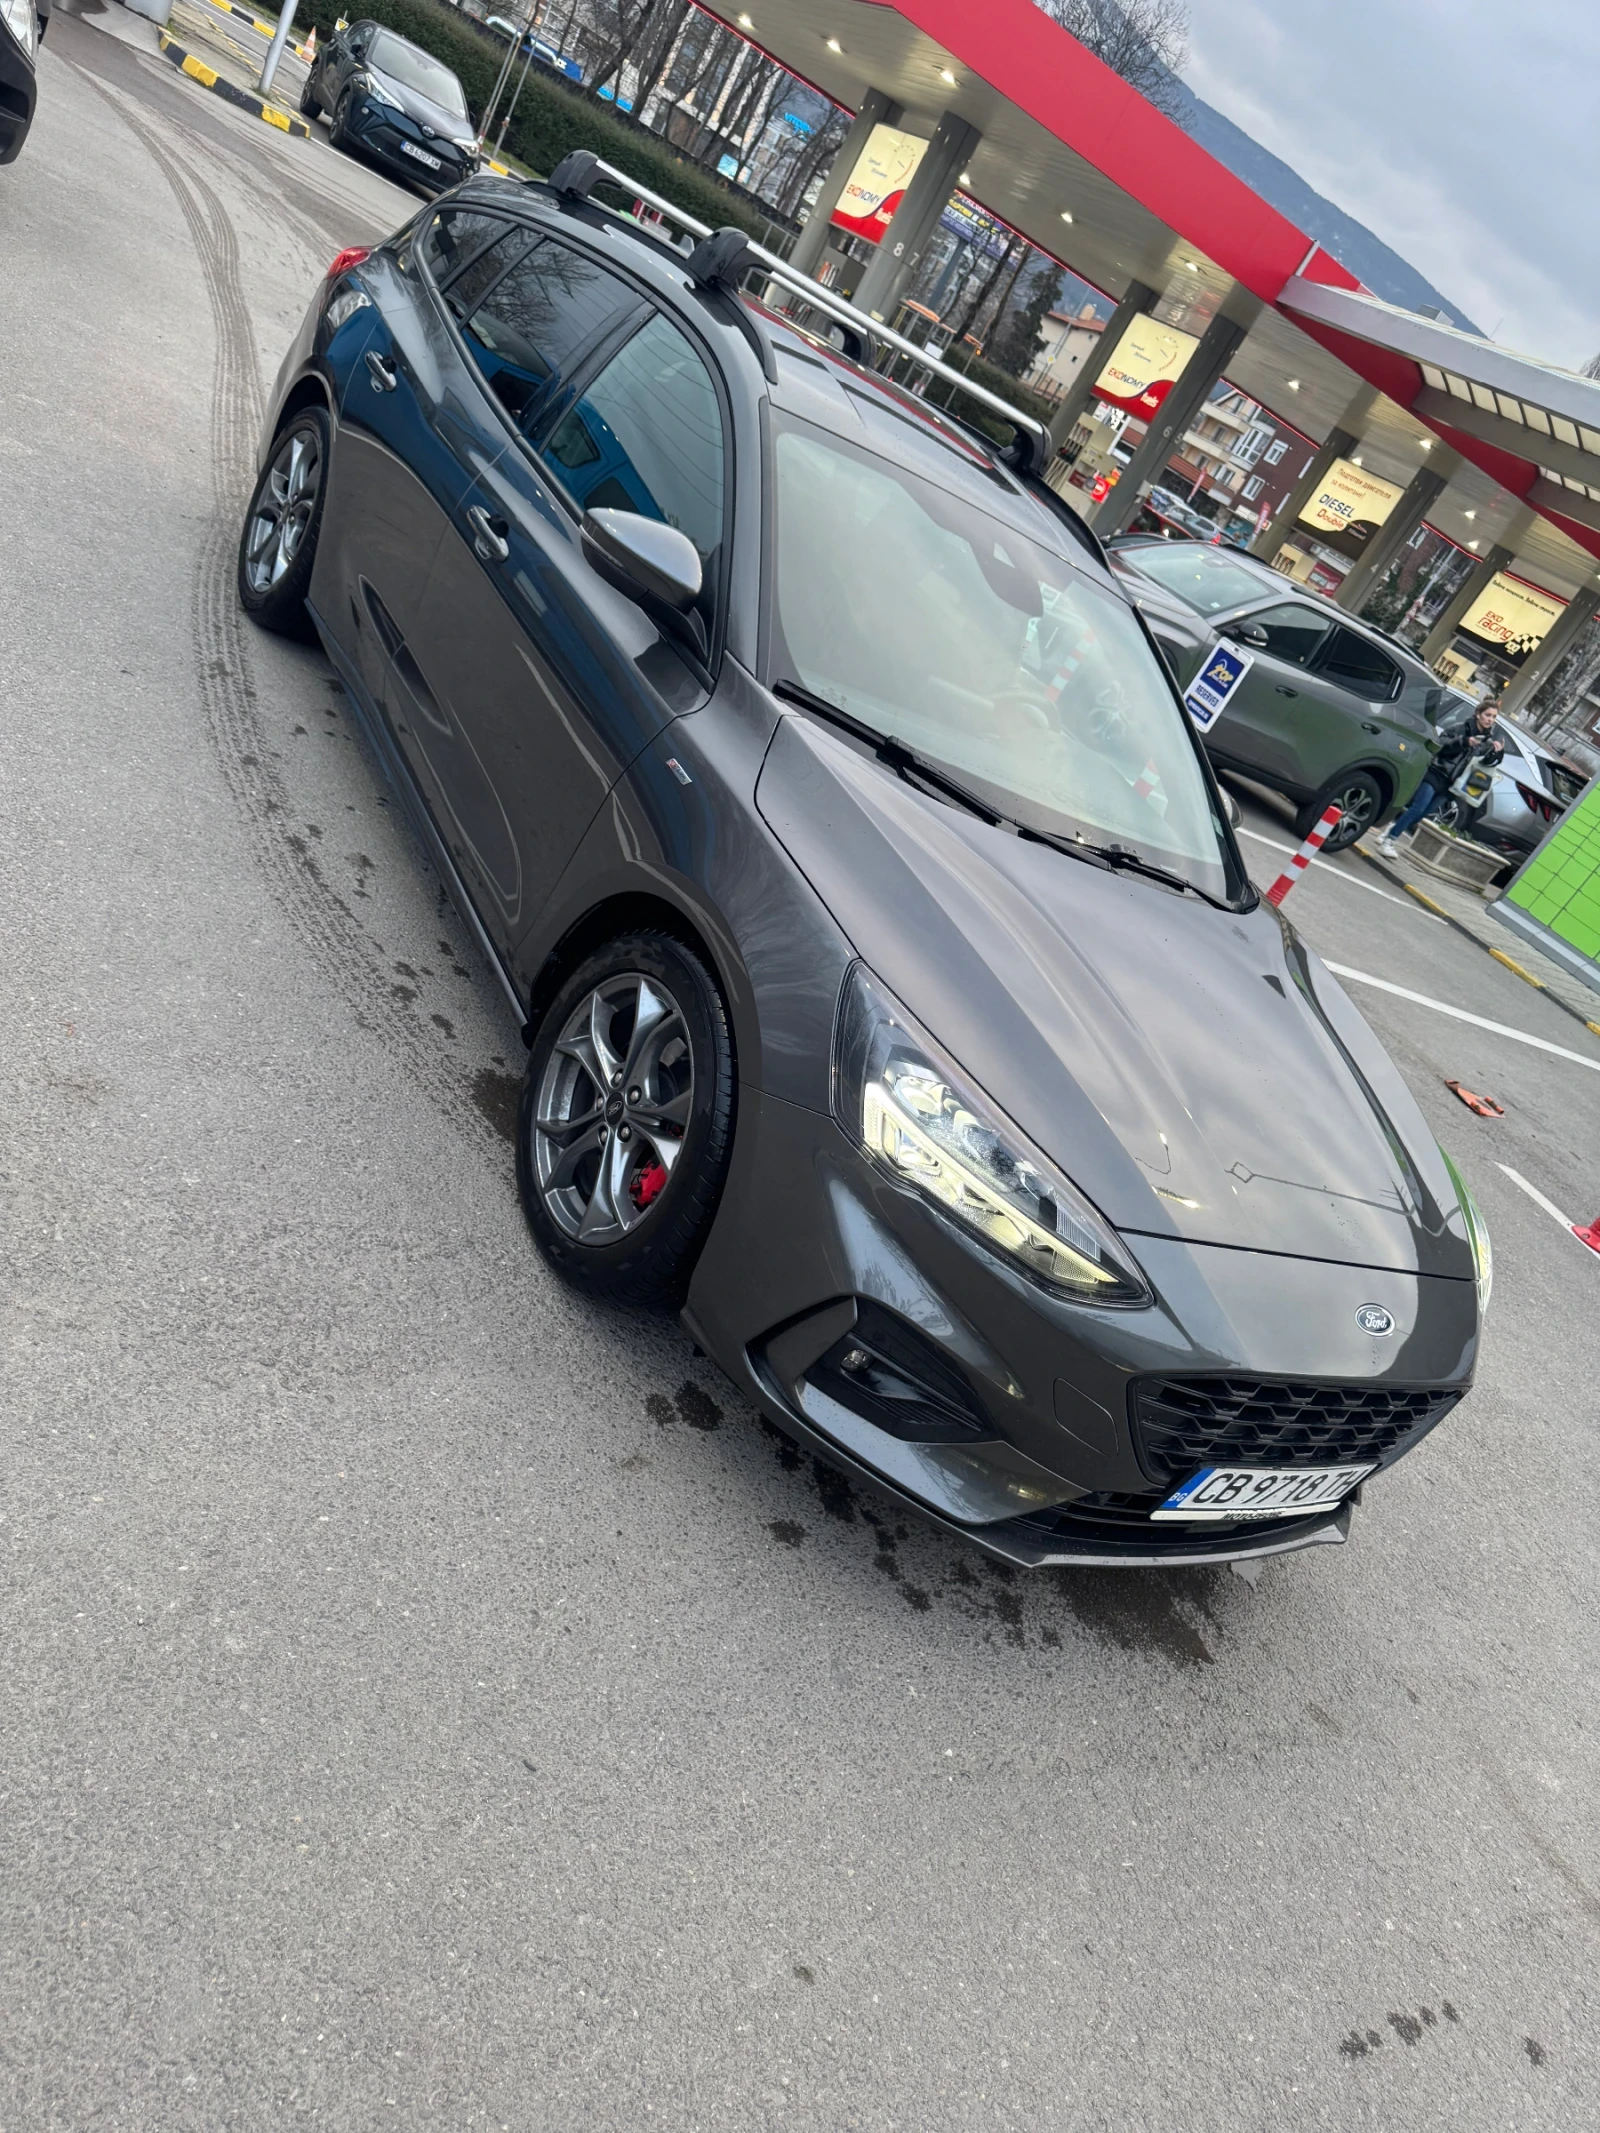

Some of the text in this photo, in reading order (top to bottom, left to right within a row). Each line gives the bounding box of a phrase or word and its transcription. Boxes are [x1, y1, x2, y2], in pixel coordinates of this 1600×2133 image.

[893, 242, 905, 257] 8
[910, 252, 920, 266] 7
[1162, 425, 1173, 438] 6
[1318, 493, 1355, 519] DIESEL
[1316, 508, 1345, 529] Double
[1485, 610, 1504, 623] EKO
[1478, 617, 1515, 642] racing
[1530, 670, 1540, 681] 2
[1195, 684, 1219, 708] RESERVED
[1365, 1311, 1388, 1329] Ford
[1192, 1468, 1370, 1504] CB 9718 TH
[1167, 1492, 1188, 1502] BG
